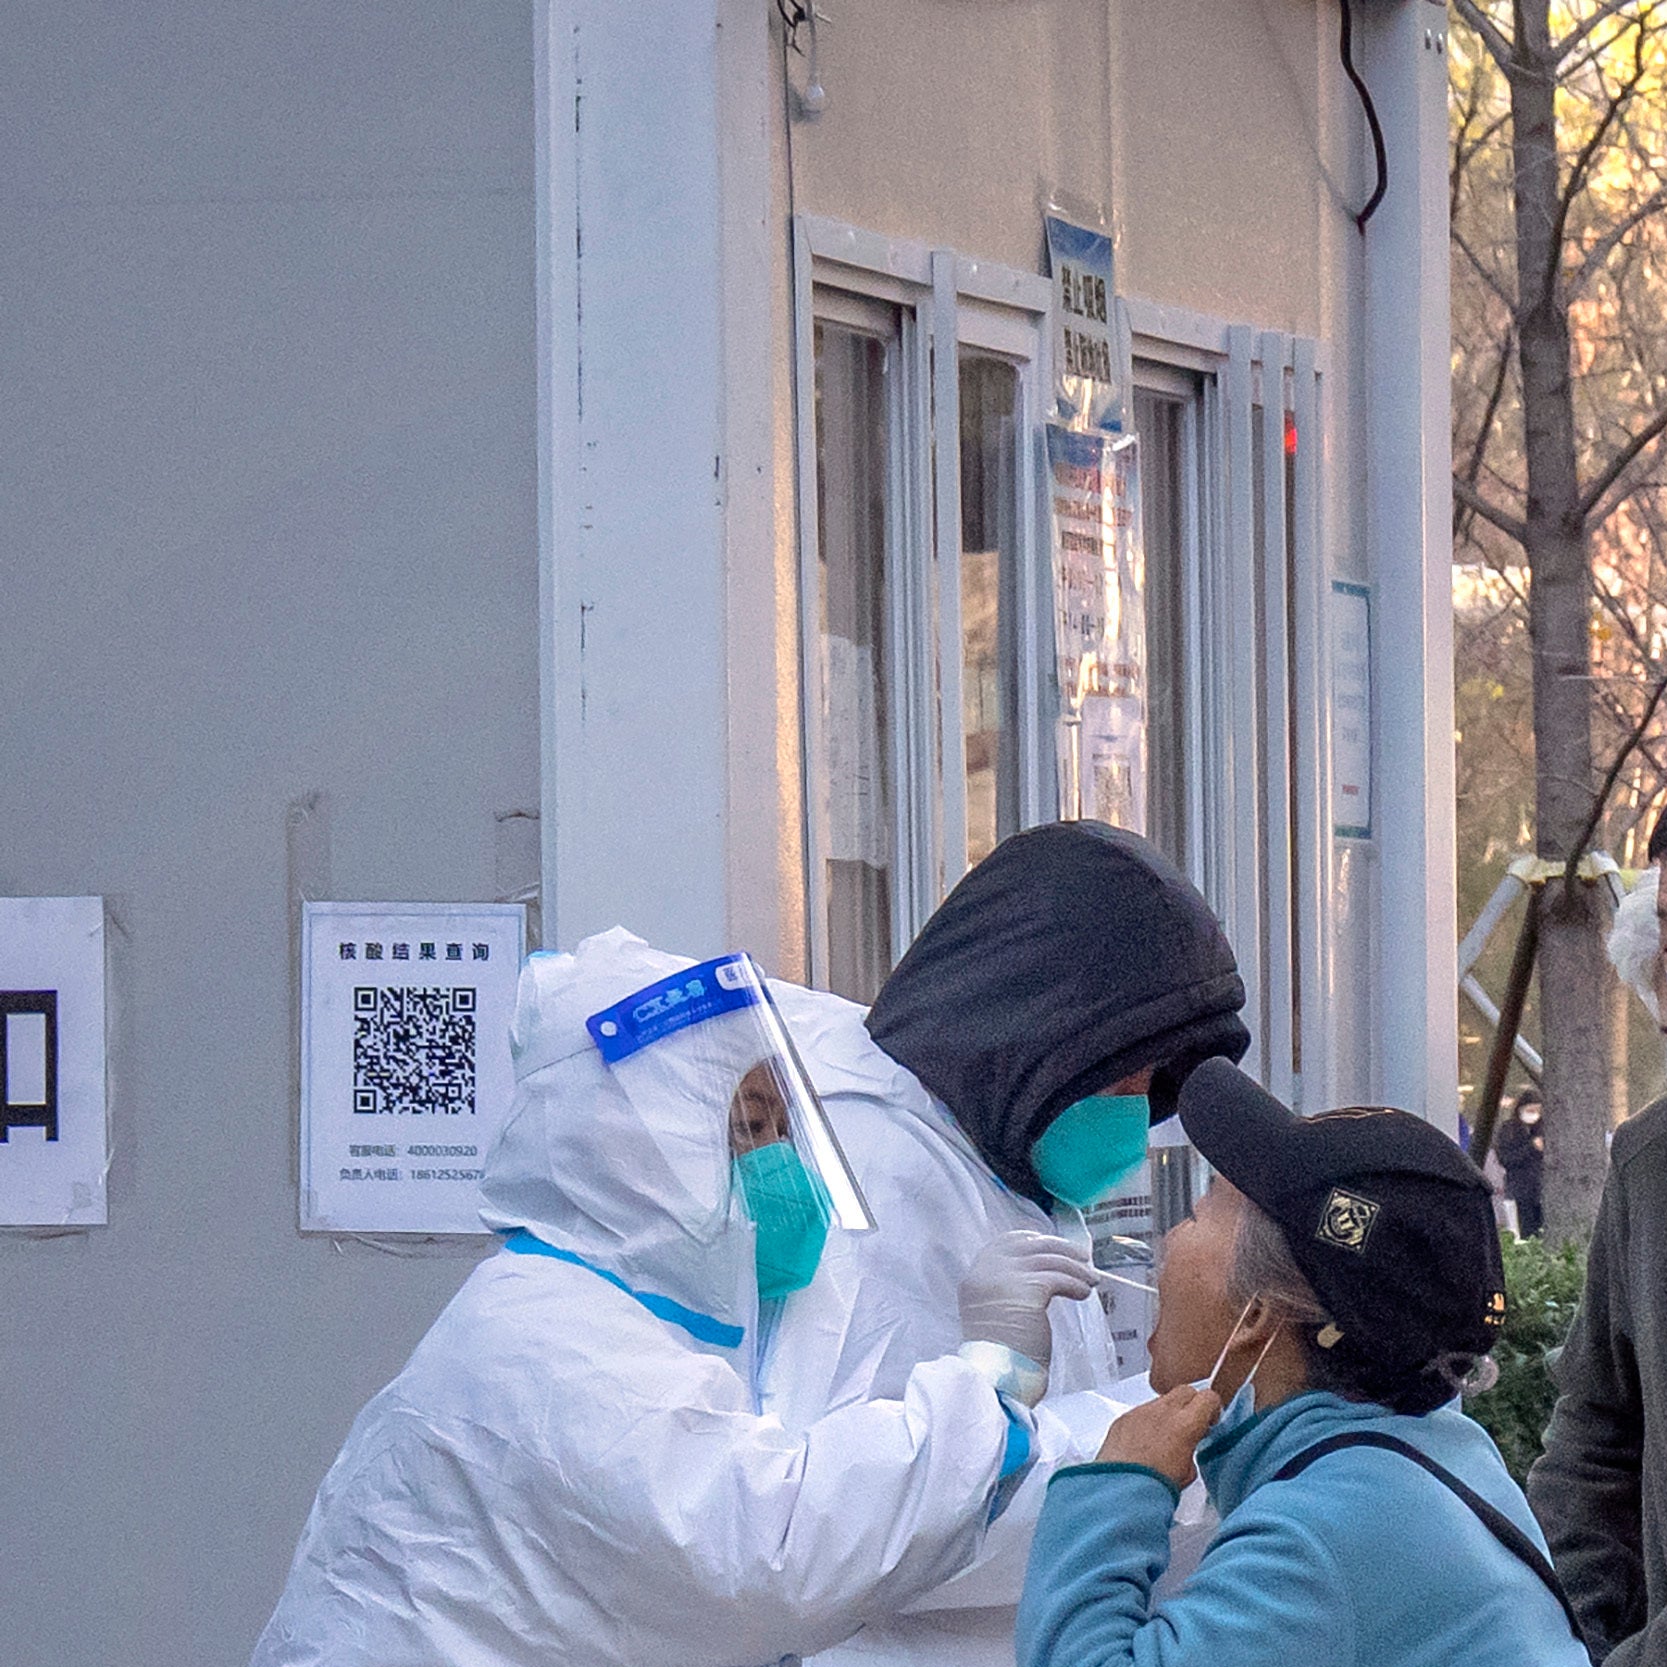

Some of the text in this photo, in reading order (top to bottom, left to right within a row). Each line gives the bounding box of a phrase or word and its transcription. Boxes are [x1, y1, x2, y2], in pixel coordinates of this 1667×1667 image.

[338, 941, 490, 961] 核酸结果查询
